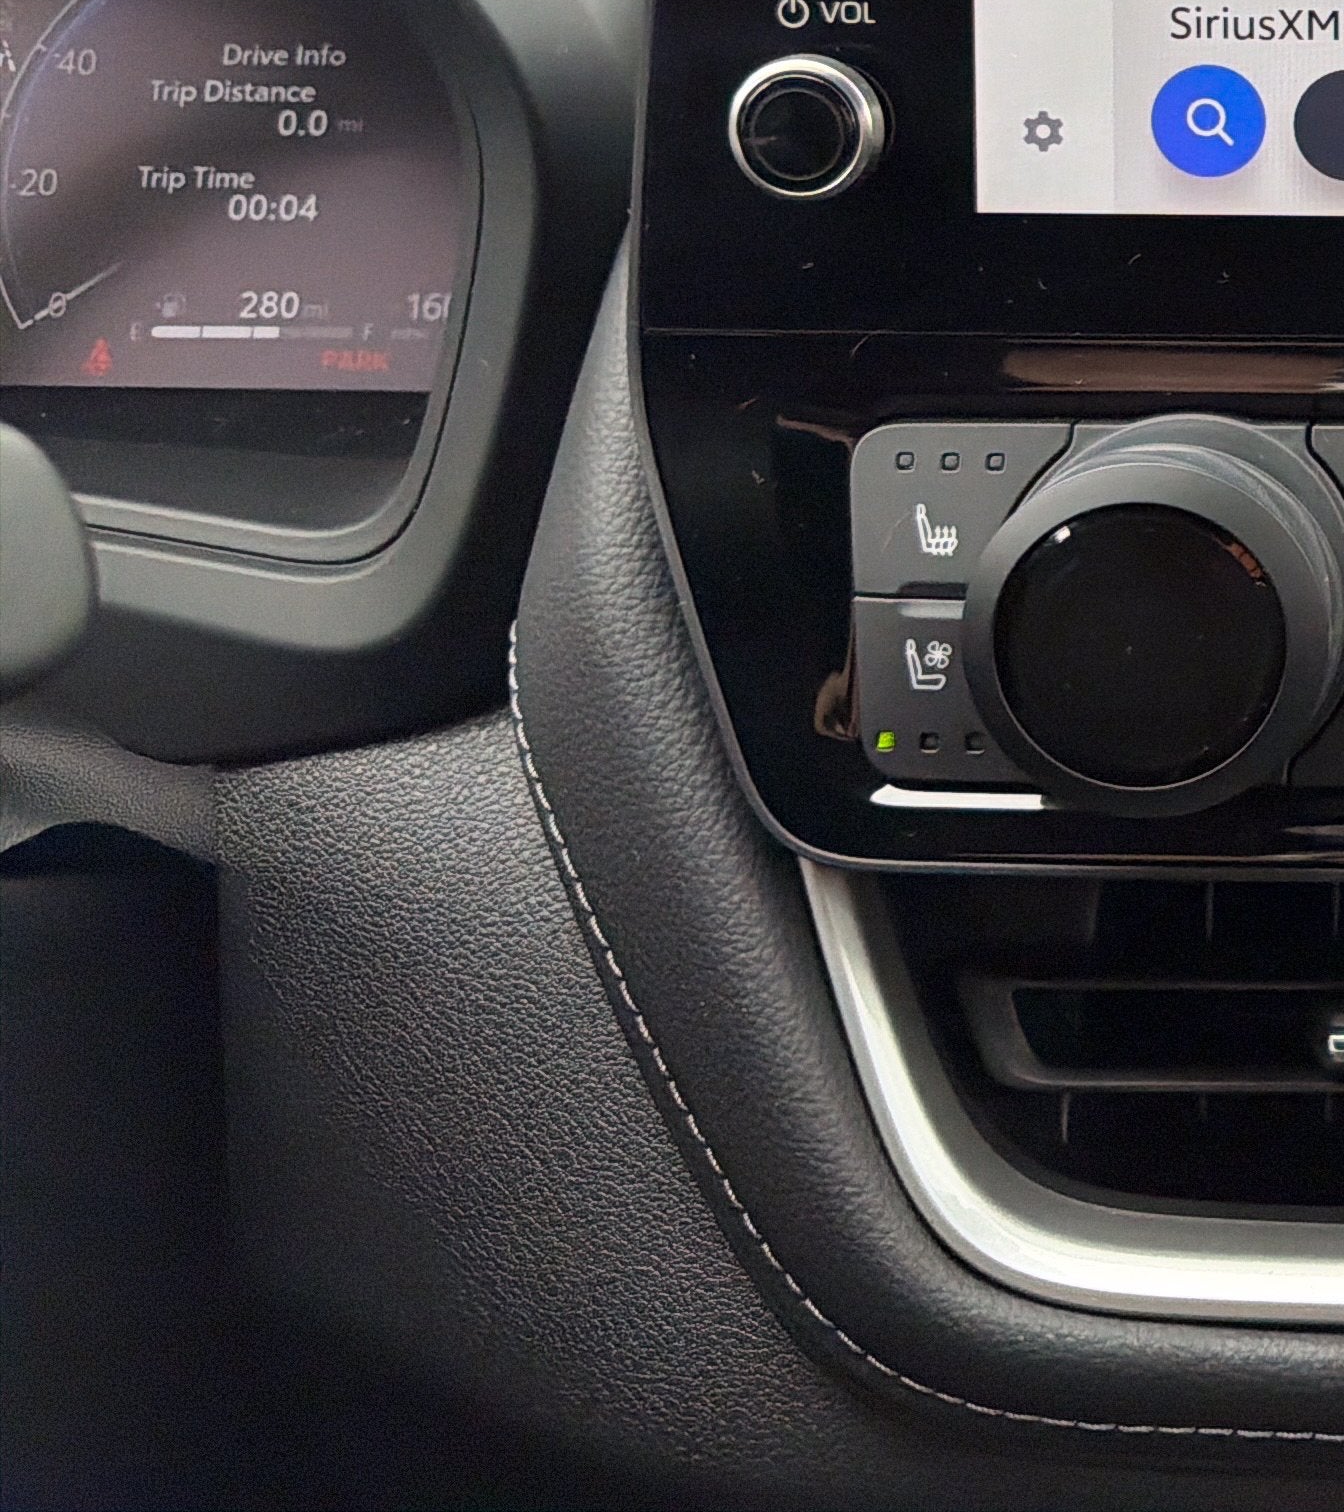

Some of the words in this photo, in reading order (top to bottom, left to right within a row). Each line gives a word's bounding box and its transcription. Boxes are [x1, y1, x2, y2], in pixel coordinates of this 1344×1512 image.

[820, 1, 875, 23] VOL
[1171, 7, 1339, 40] SiriusXM
[57, 47, 98, 77] 40
[221, 42, 290, 68] Drive
[295, 42, 348, 68] Info
[150, 78, 199, 109] Trip
[203, 78, 318, 105] Distance
[277, 108, 329, 138] 0.0
[17, 168, 60, 198] 20
[137, 164, 187, 195] Trip
[193, 164, 257, 191] Time
[226, 192, 320, 223] 00:04
[237, 290, 301, 321] 280
